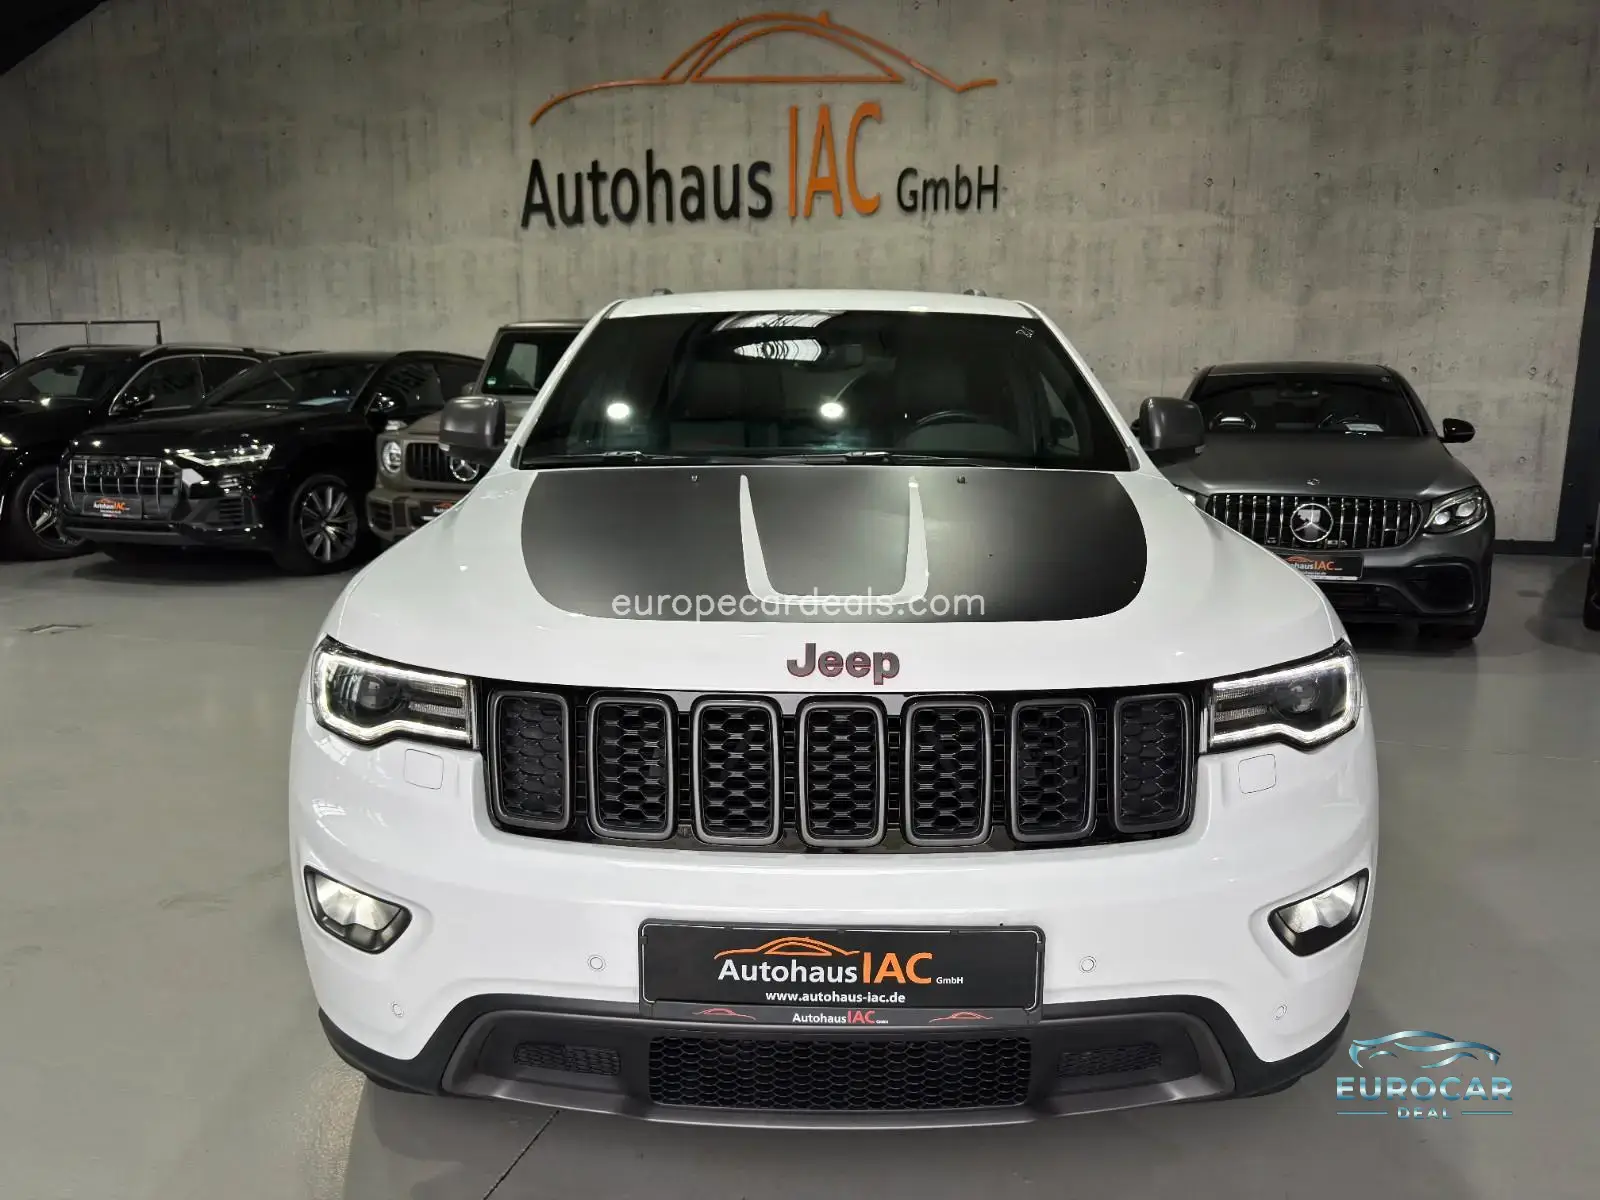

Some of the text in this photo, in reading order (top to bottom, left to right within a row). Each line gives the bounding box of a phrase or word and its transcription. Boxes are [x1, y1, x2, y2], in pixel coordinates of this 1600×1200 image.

[521, 101, 999, 229] Autohaus IAC GmbH
[1314, 561, 1334, 570] IAC
[786, 642, 900, 685] Jeep
[717, 951, 964, 985] Autohaus IAC GmbH
[765, 991, 906, 1005] www.autohaus-iac.de
[792, 1012, 847, 1024] Autohaus
[847, 1010, 876, 1025] IAC
